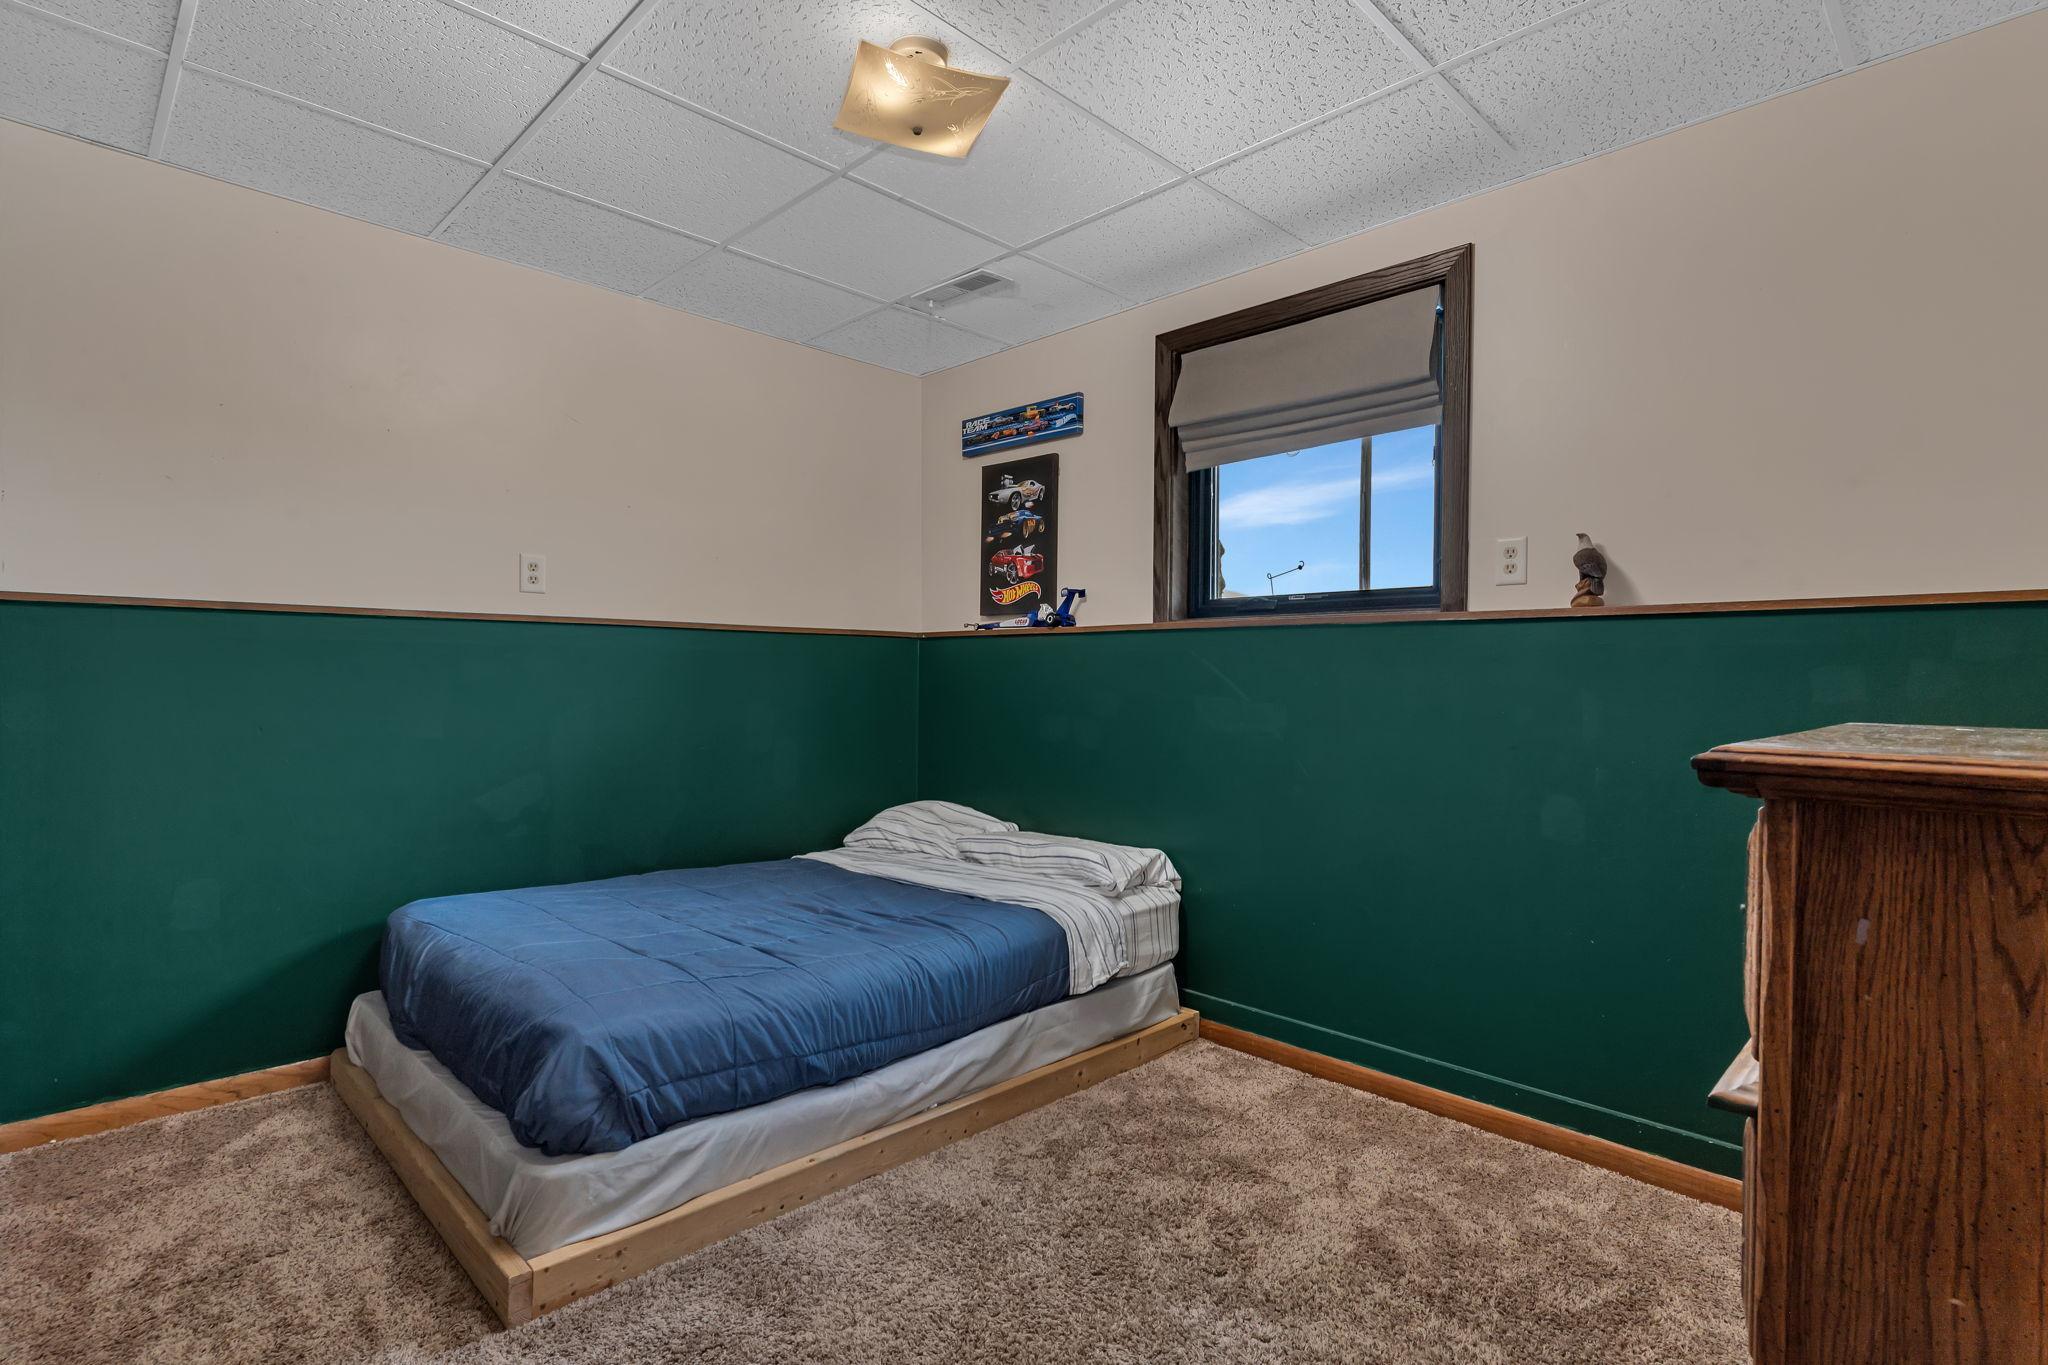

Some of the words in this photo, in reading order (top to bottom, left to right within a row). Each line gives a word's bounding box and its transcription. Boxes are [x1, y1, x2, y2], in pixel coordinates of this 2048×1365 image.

[966, 416, 990, 428] RACE
[963, 424, 987, 434] TEAM
[1003, 588, 1016, 603] HOT
